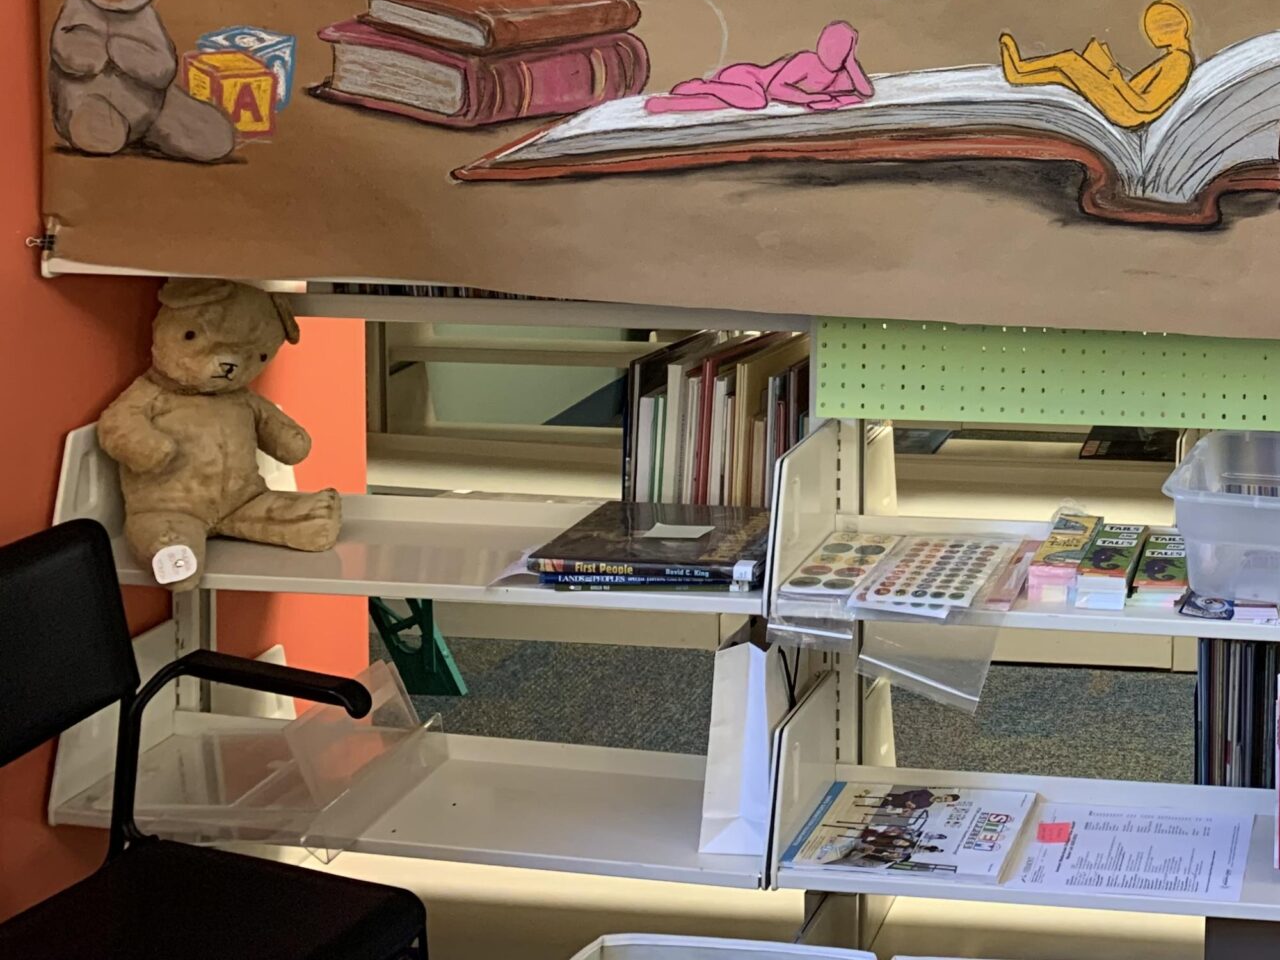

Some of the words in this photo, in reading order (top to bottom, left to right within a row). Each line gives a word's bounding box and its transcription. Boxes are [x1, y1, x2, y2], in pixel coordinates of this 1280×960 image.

[231, 82, 264, 123] A
[575, 562, 595, 573] First
[600, 563, 633, 574] People
